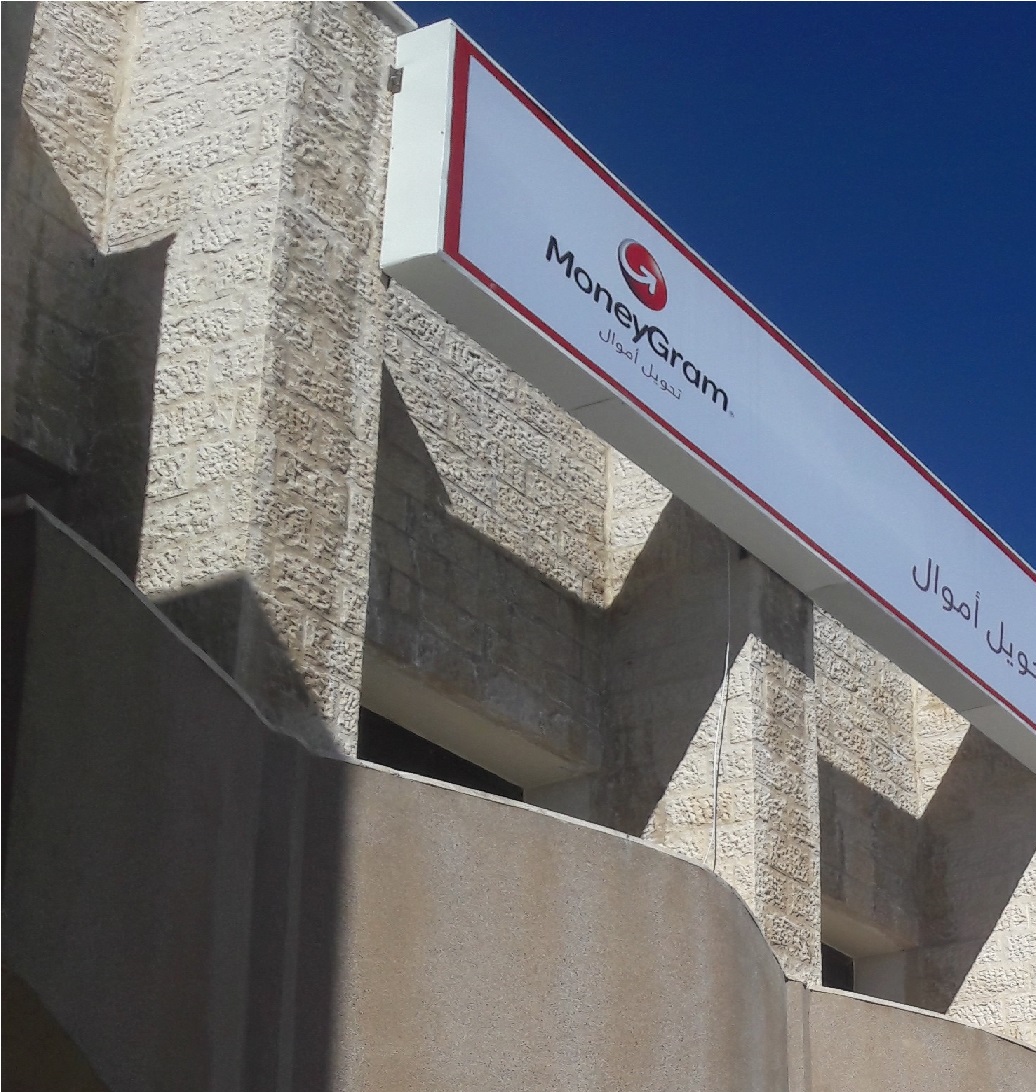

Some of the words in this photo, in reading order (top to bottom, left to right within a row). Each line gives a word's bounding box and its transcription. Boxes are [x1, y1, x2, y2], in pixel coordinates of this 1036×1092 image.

[545, 235, 729, 412] MoneyGram
[598, 328, 639, 365] أموال
[641, 363, 682, 400] تحويل
[912, 557, 981, 629] أموال
